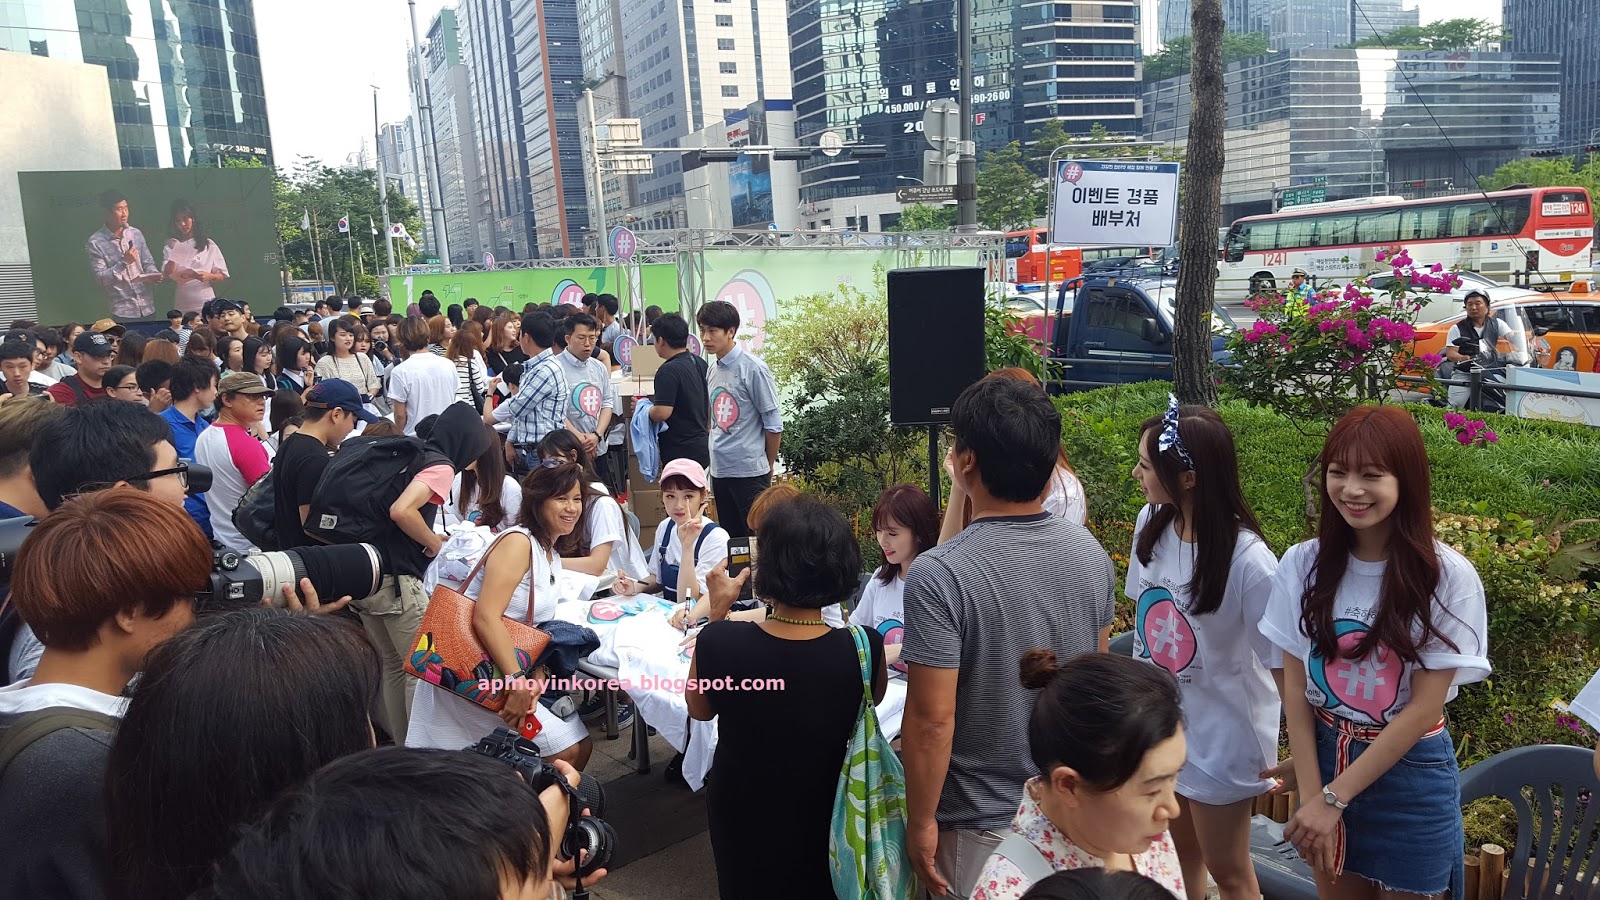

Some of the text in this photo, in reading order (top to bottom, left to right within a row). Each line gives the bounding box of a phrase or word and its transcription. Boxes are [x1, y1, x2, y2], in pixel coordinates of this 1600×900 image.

[1072, 187, 1159, 205] 이벤트 경품
[1570, 203, 1585, 213] 1241
[1092, 210, 1141, 227] 배부처
[1262, 252, 1287, 267] 1241
